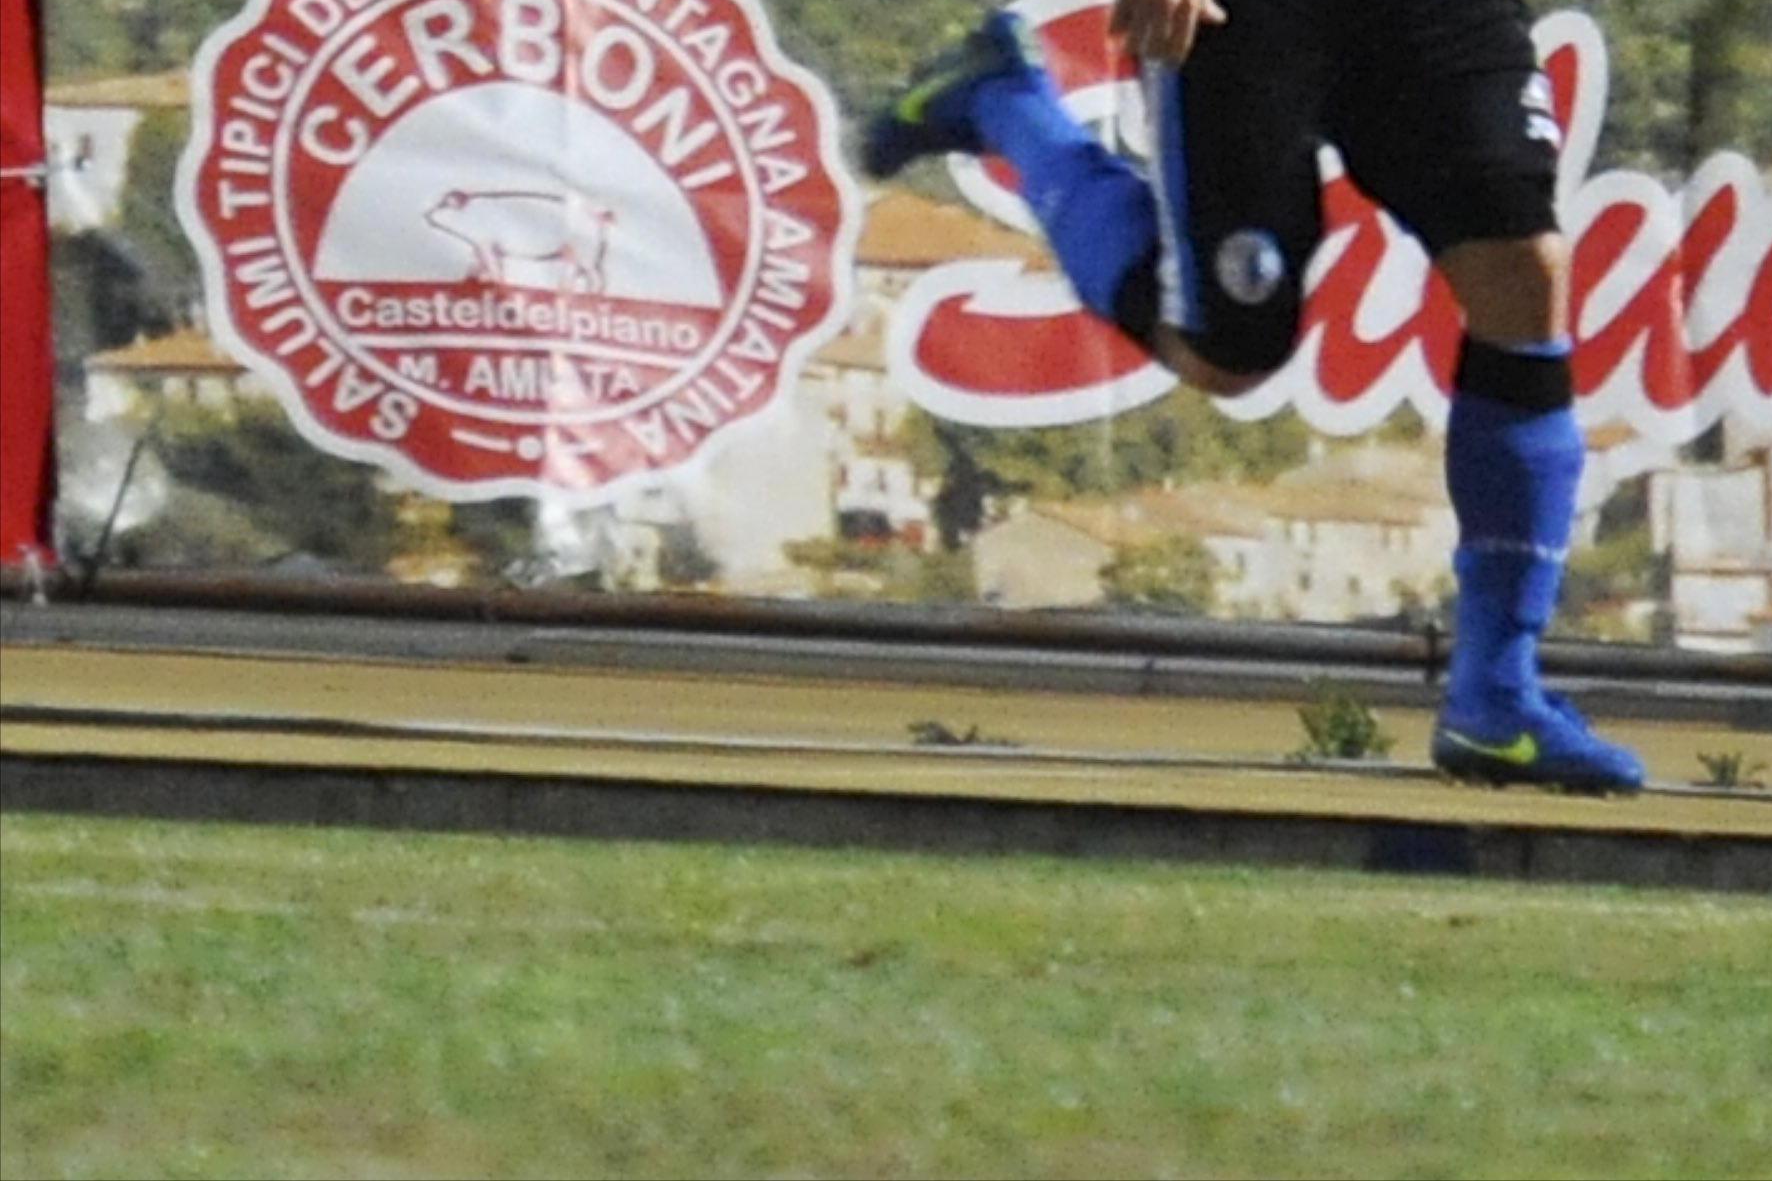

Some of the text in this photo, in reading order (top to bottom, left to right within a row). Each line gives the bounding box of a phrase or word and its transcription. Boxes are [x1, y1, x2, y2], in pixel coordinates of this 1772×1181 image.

[218, 33, 306, 219] TIPICI
[227, 236, 419, 440] SALUMI
[336, 289, 701, 350] Casteldelpiano
[398, 354, 450, 390] M.
[629, 209, 813, 458] AMIATINA
